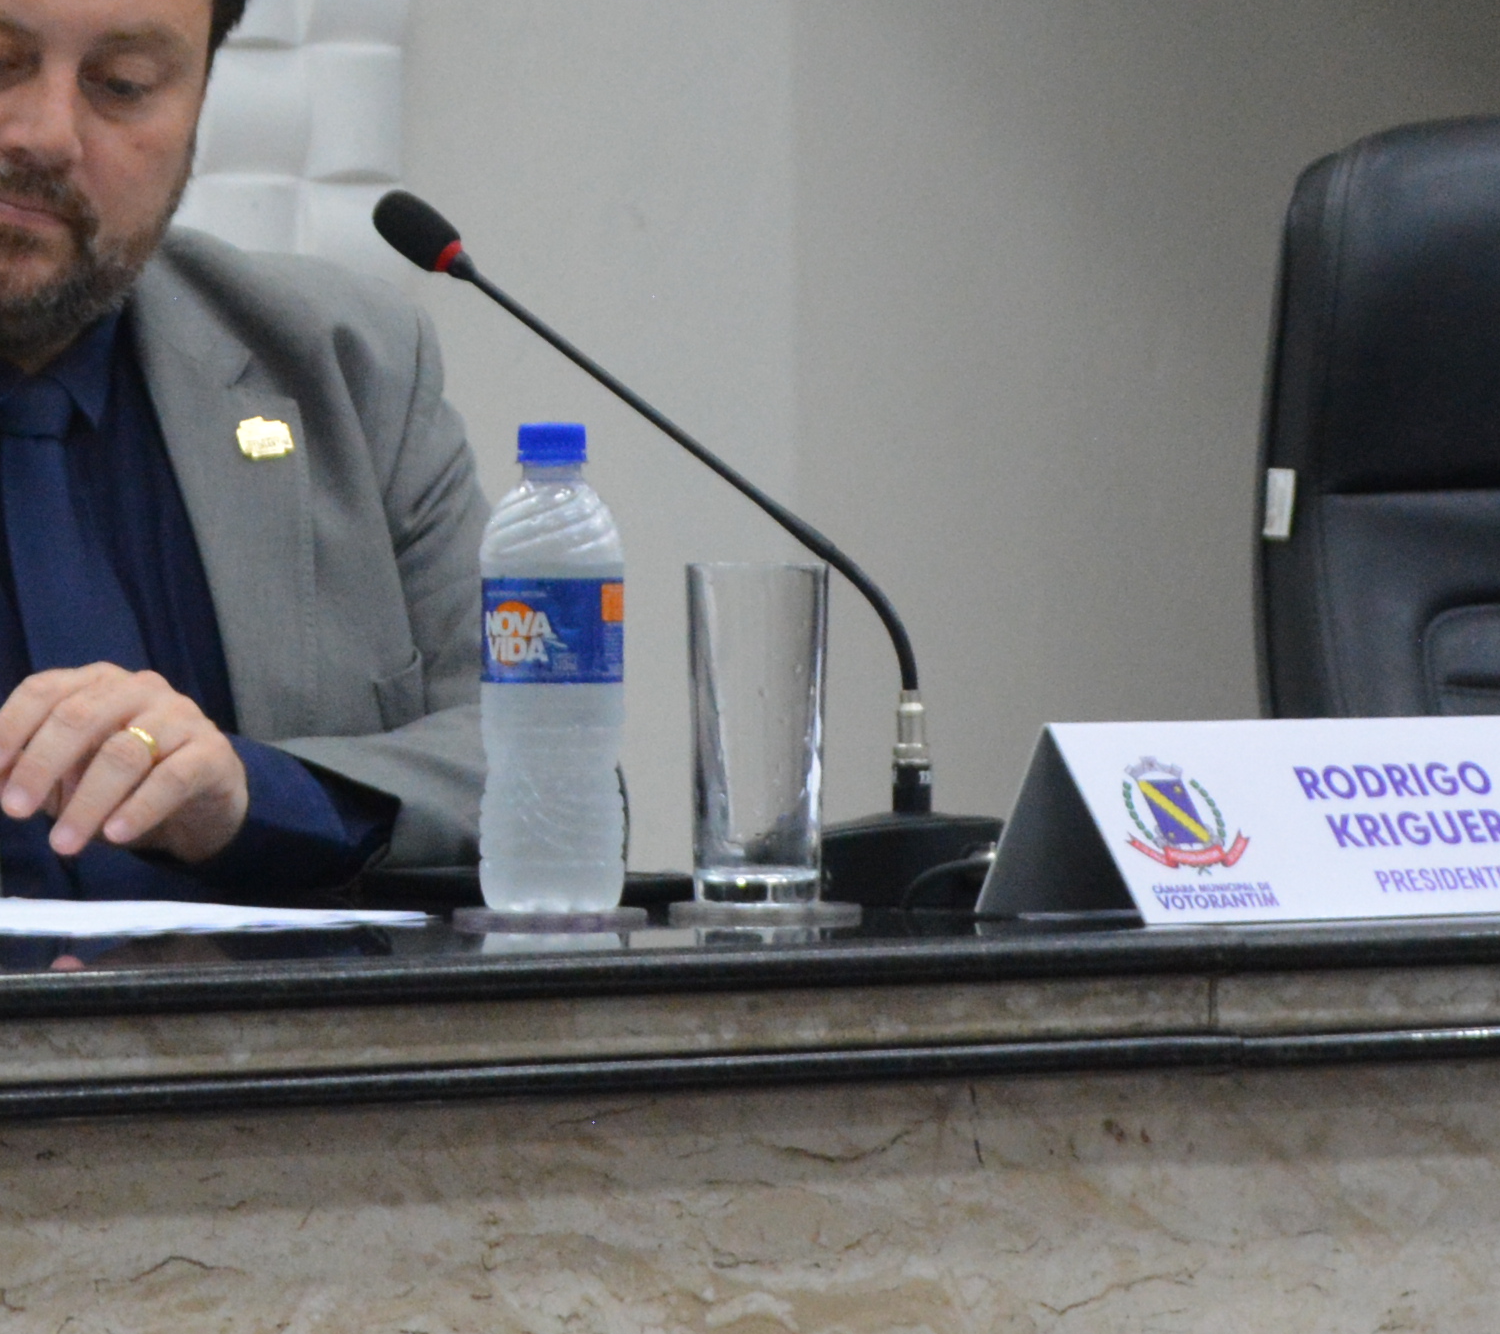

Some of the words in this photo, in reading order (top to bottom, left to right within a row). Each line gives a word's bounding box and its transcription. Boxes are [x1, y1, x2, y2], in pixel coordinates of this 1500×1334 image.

[485, 610, 557, 639] NOVA
[488, 636, 549, 662] VIDA
[1293, 760, 1493, 800] RODRIGO
[1156, 893, 1279, 910] VOTORANTIM
